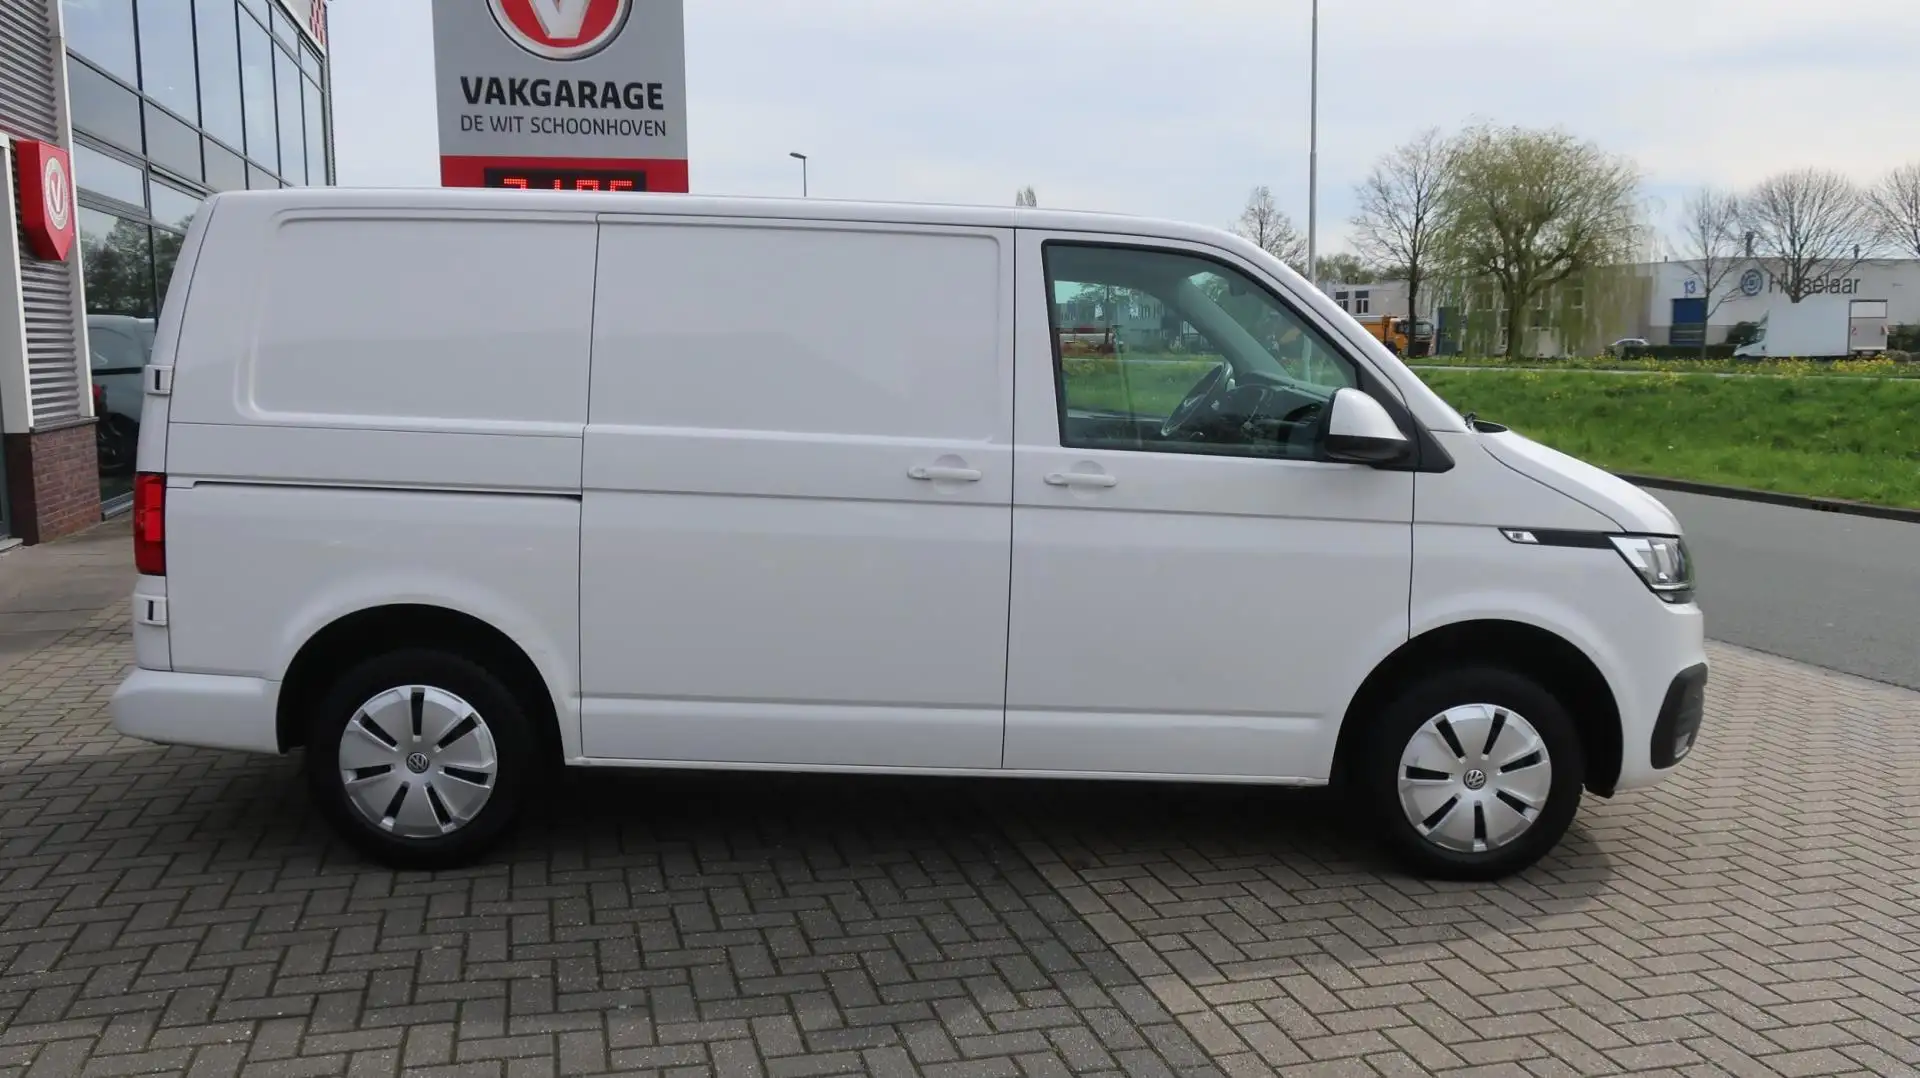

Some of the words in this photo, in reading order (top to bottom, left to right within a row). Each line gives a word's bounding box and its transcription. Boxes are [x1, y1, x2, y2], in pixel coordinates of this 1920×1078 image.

[460, 76, 664, 110] VAKGARAGE
[461, 115, 484, 132] DE
[490, 116, 524, 133] WIT
[531, 117, 666, 137] SCHOONHOVEN
[1683, 281, 1696, 294] 13
